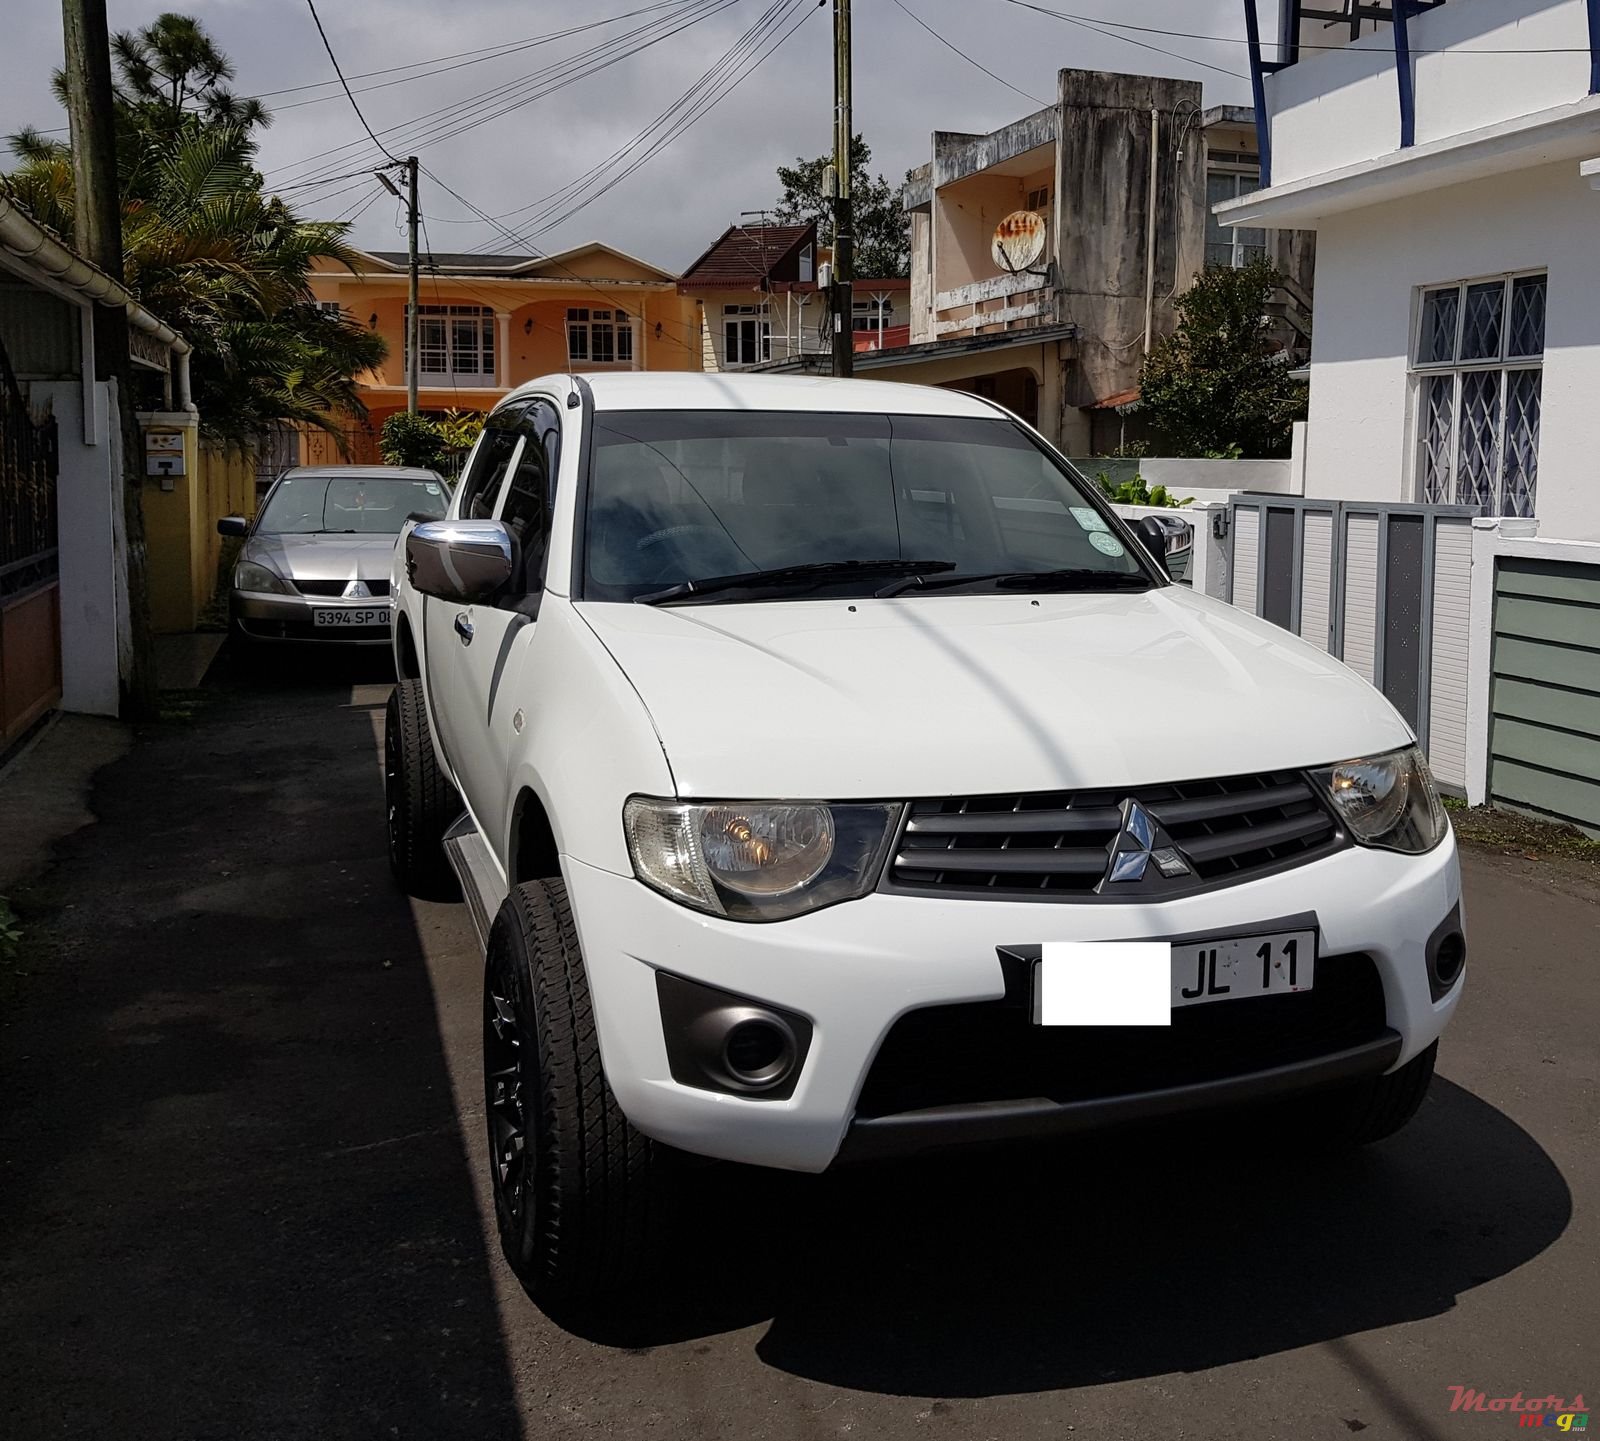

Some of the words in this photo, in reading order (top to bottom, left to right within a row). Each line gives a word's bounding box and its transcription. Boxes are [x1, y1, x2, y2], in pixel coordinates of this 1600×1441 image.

[318, 611, 351, 625] 5394
[355, 611, 375, 624] SP
[1181, 948, 1231, 999] JL
[1255, 938, 1298, 989] 11
